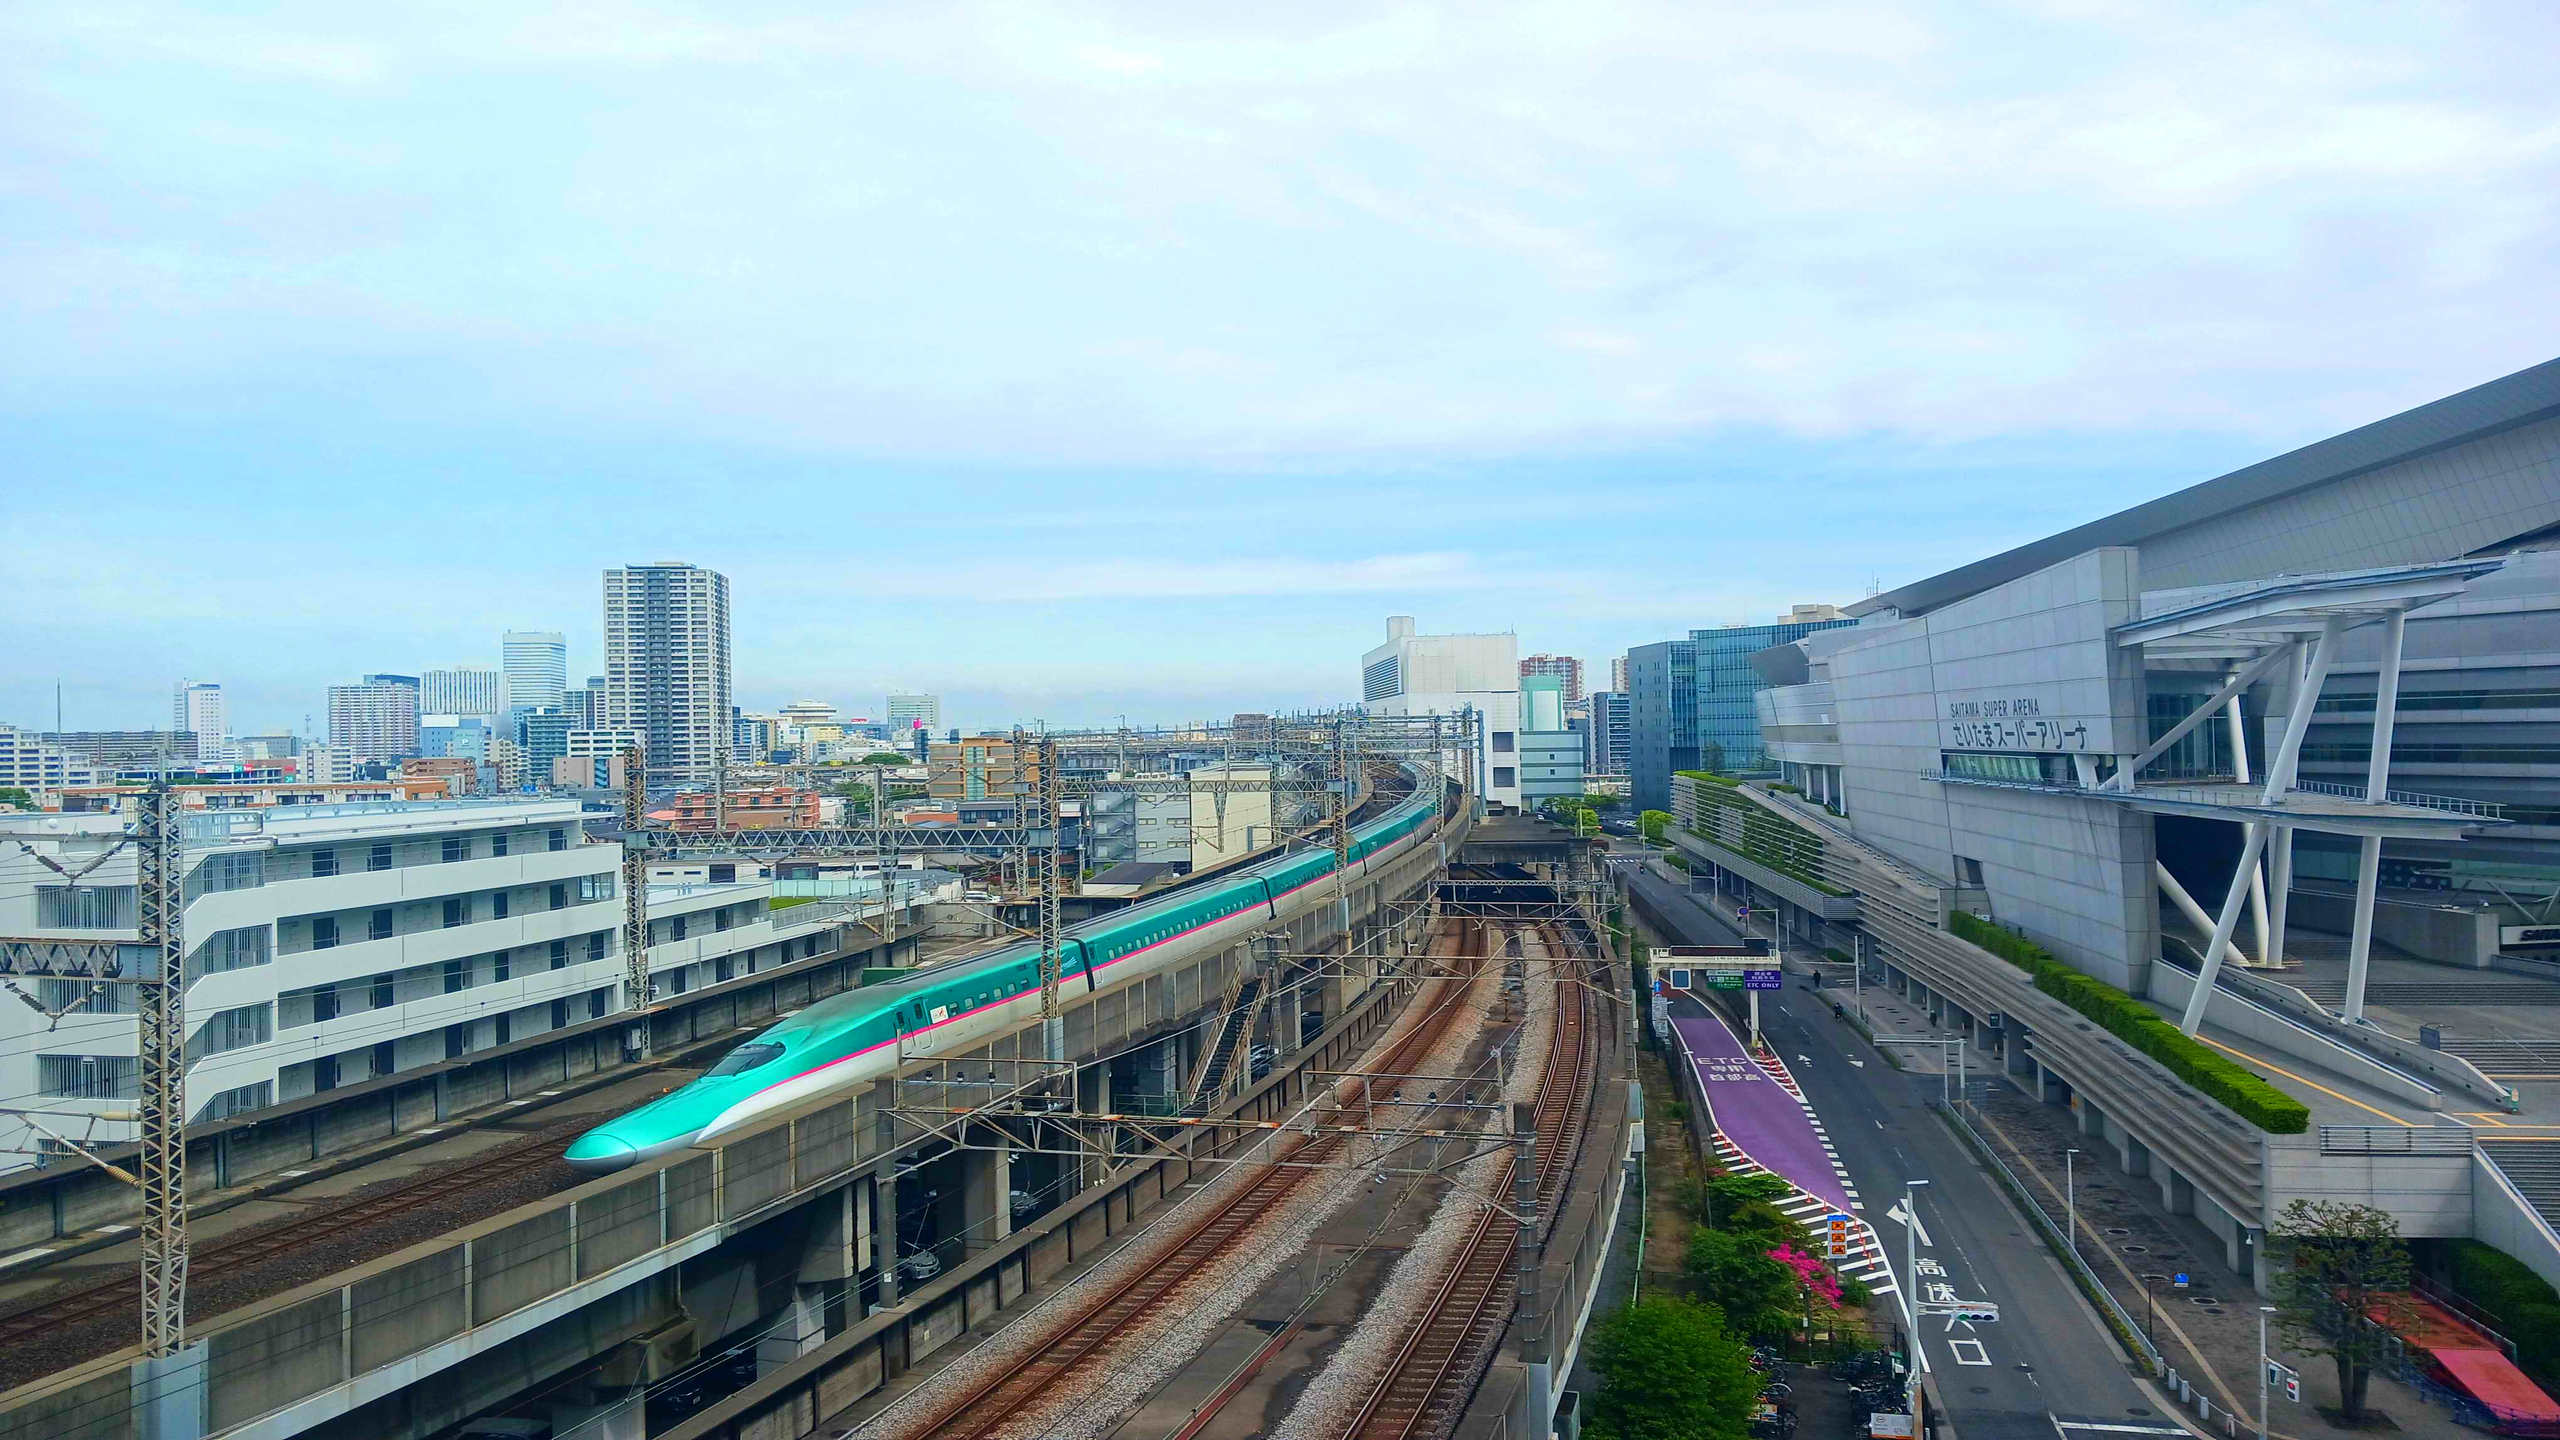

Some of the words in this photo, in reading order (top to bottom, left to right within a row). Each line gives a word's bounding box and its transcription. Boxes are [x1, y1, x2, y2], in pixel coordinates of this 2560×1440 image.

[1950, 702, 1980, 718] SAITAMA
[1984, 700, 2008, 717] SUPER
[2013, 698, 2040, 716] ARENA
[1953, 719, 2087, 750] さいたまスーパーアリーナ
